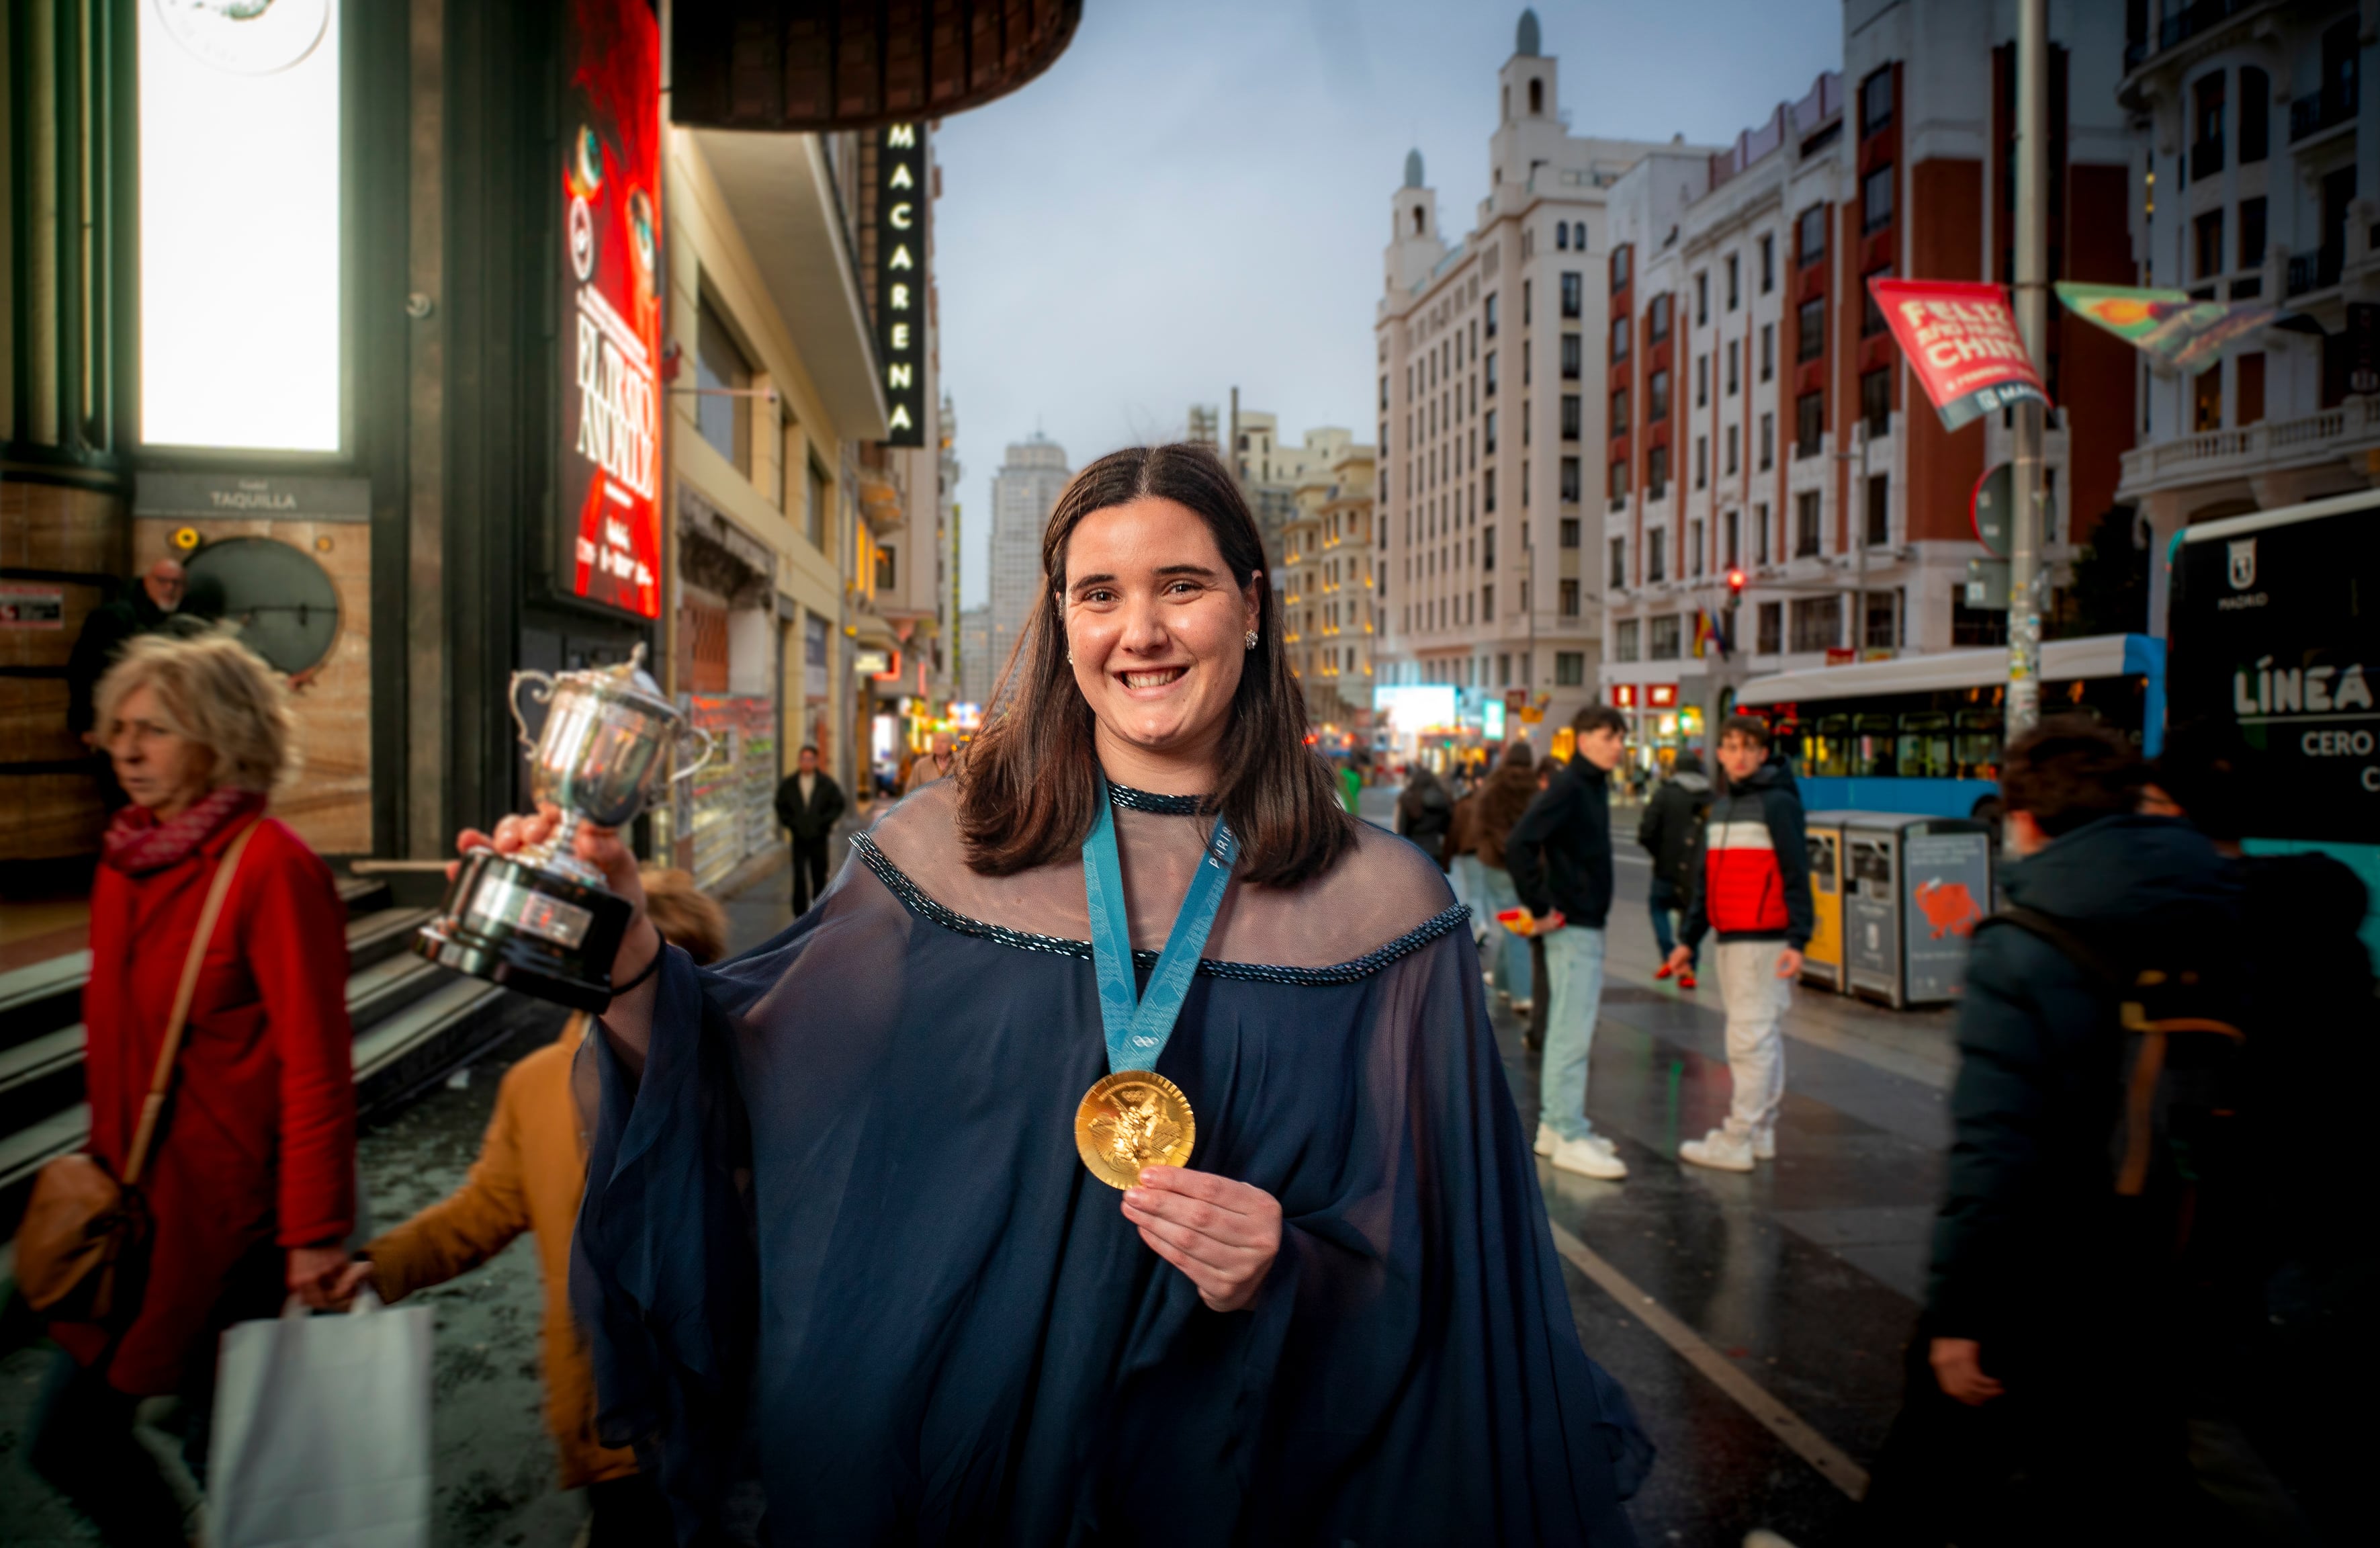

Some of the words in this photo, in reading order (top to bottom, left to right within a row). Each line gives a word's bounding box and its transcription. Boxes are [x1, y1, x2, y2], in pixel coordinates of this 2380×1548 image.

[887, 123, 916, 430] MACARENA
[1899, 300, 2009, 327] FELIZ
[1926, 337, 2026, 368] CHIN
[210, 491, 297, 510] TAQUILLA
[2218, 592, 2268, 610] MADRID
[2234, 654, 2374, 715] LÍNEA
[2301, 730, 2375, 757] CERO
